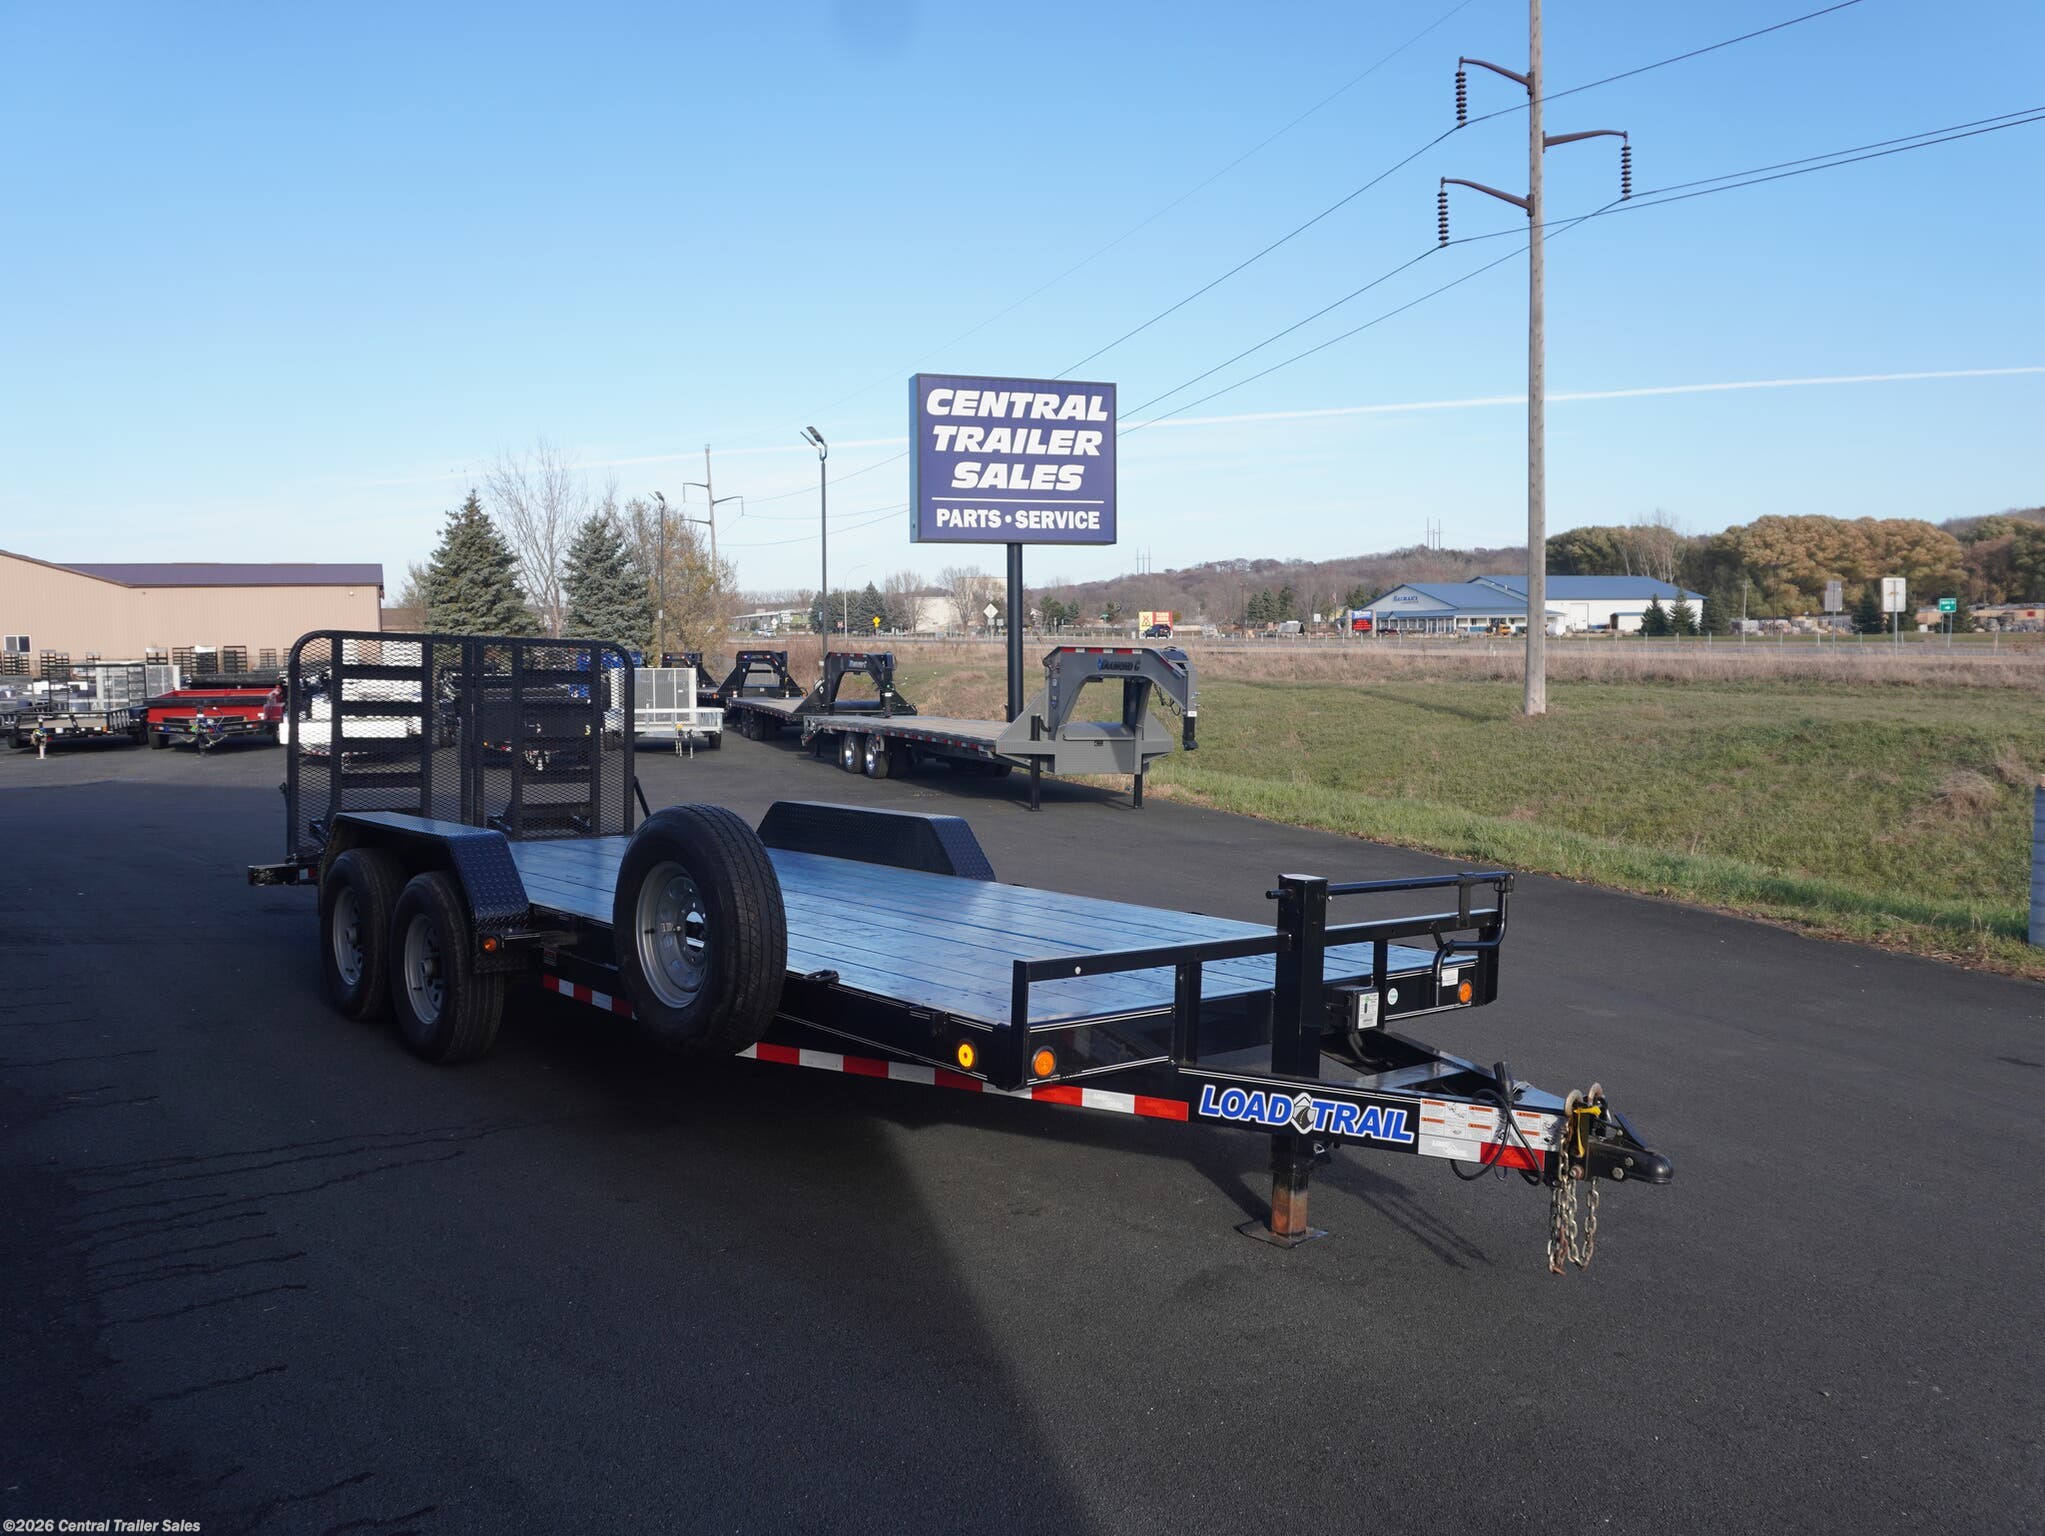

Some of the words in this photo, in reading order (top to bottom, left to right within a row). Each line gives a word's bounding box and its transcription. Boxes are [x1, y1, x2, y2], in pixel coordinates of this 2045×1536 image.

[926, 388, 1109, 422] CENTRAL
[932, 425, 1103, 456] TRAILER
[951, 461, 1086, 491] SALES
[936, 508, 1001, 528] PARTS
[1015, 510, 1101, 530] SERVICE
[1200, 1085, 1295, 1127] LOAD
[1311, 1098, 1415, 1144] TRAIL
